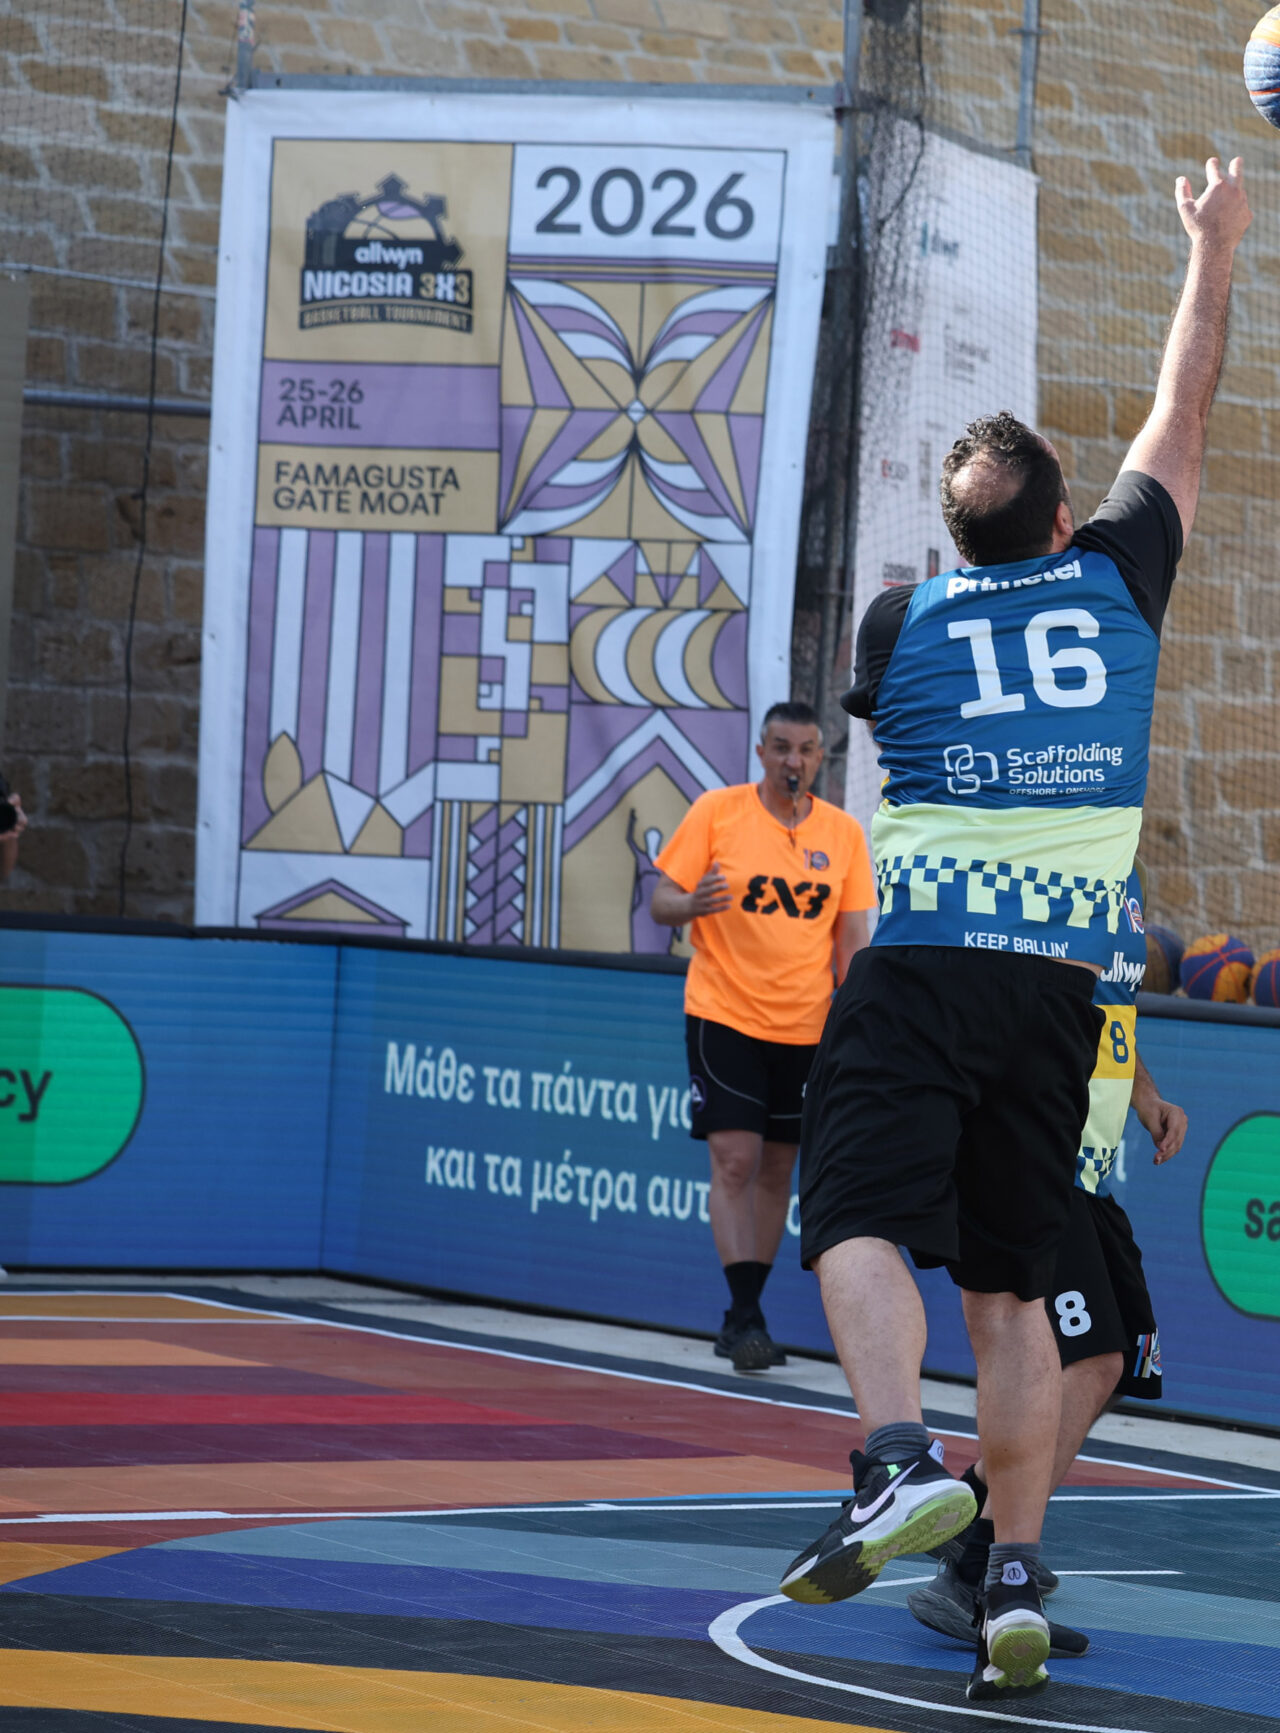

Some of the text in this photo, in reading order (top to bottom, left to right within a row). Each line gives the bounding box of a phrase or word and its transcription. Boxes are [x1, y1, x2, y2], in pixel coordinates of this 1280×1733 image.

[534, 165, 755, 241] 2026
[354, 241, 424, 270] allwyn
[303, 269, 414, 301] NICOSIA
[279, 377, 365, 404] 25-26
[277, 403, 361, 430] APRIL
[274, 460, 461, 491] FAMAGUSTA
[273, 486, 446, 516] GATE MOAT
[947, 608, 1108, 719] 16
[1006, 742, 1123, 766] Scaffolding
[1008, 764, 1105, 785] Solutions
[1009, 787, 1057, 796] OFFSHORE
[964, 931, 1069, 958] KEEP BALLIN'
[1109, 1020, 1129, 1064] 8
[384, 1041, 475, 1103] Μάθε
[483, 1066, 521, 1110] τα
[531, 1060, 638, 1124] πάντα
[424, 1145, 476, 1191] και
[485, 1152, 522, 1197] τα
[530, 1149, 637, 1223] μέτρα
[1054, 1290, 1092, 1337] 8
